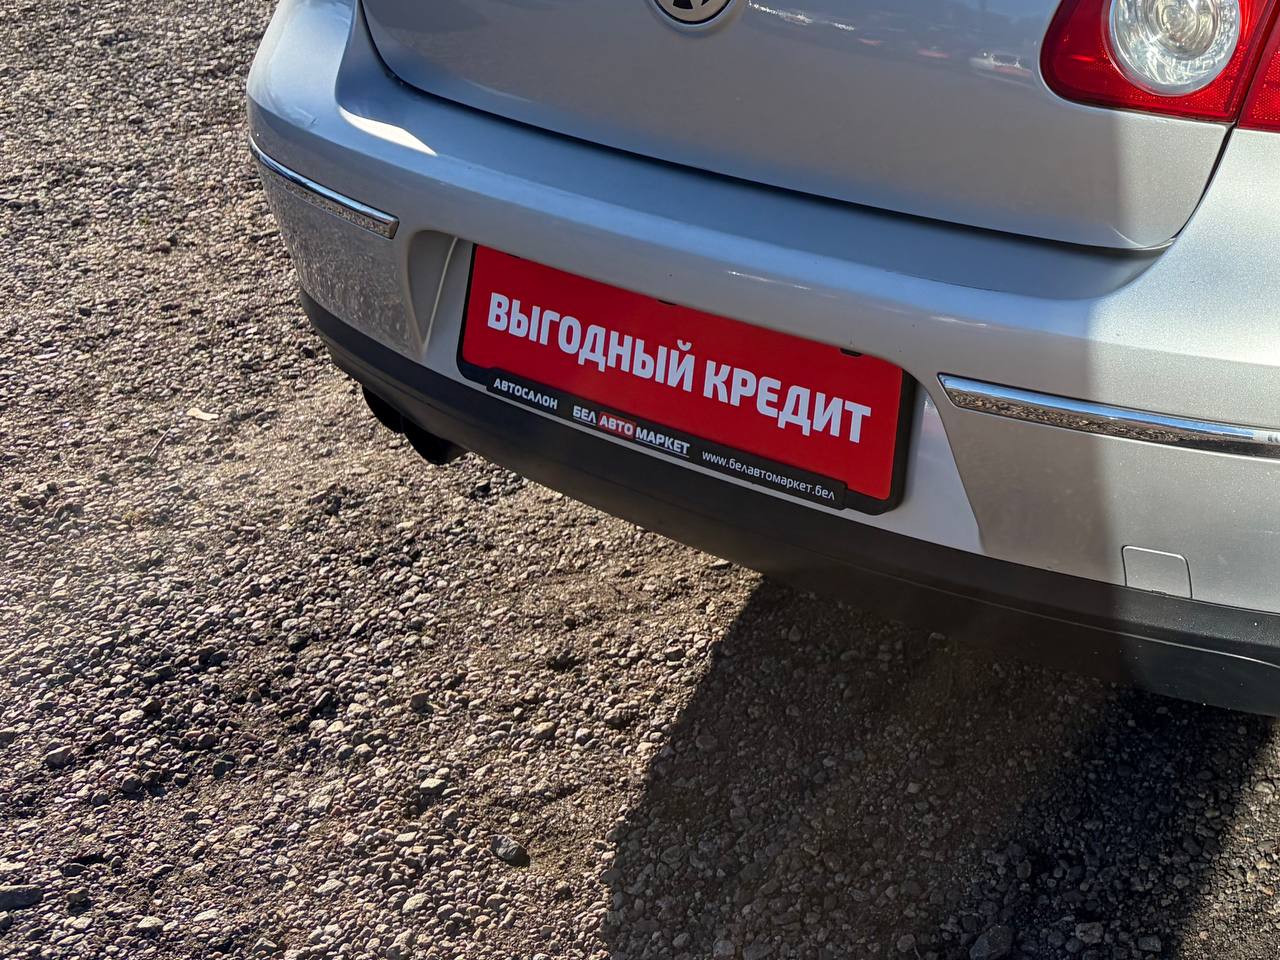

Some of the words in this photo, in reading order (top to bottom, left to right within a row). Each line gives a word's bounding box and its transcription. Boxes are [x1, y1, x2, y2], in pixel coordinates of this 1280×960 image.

[487, 291, 696, 393] ВЫГОДНЫЙ
[703, 359, 872, 444] КРЕДИТ
[493, 378, 558, 410] АВТОСАЛОН
[572, 405, 597, 424] БЕЛ
[600, 415, 633, 436] АВТО
[635, 426, 690, 455] МАРКЕТ
[702, 450, 836, 501] www.белавтомаркет.бел
